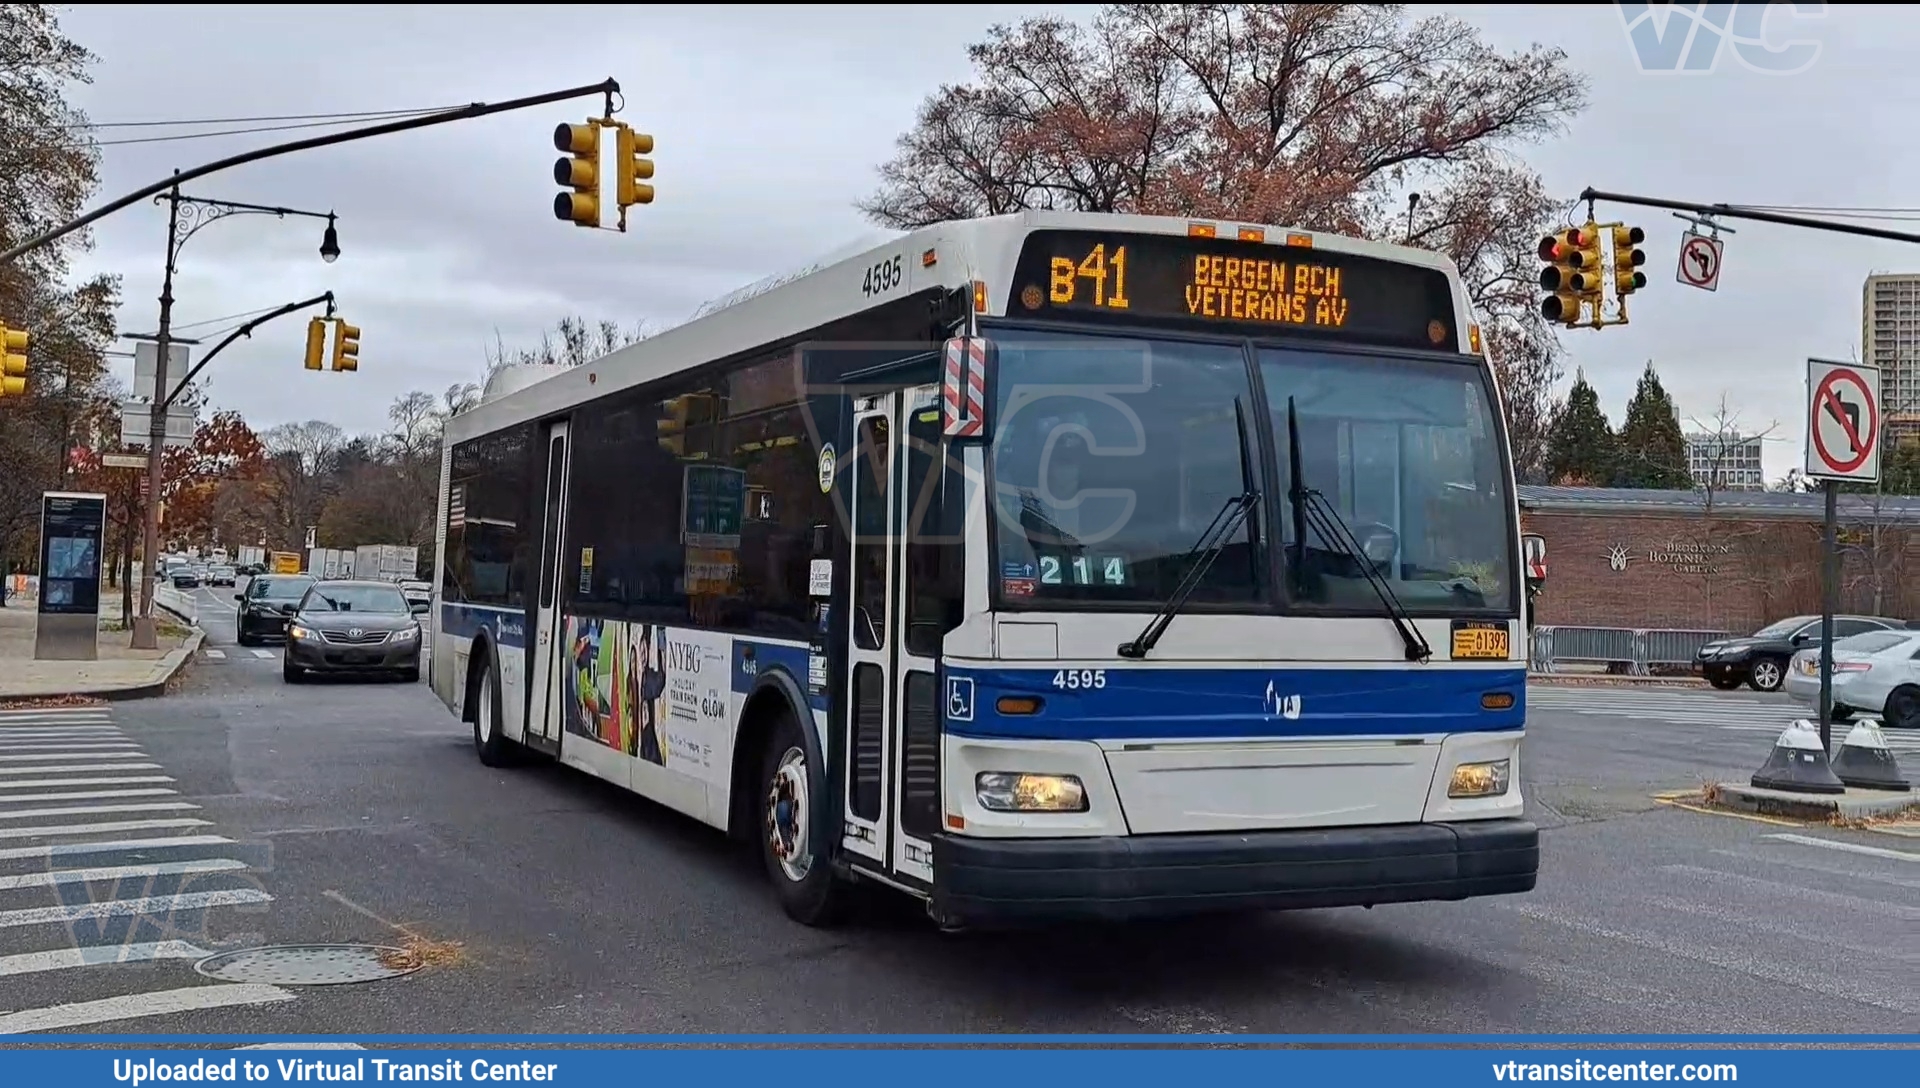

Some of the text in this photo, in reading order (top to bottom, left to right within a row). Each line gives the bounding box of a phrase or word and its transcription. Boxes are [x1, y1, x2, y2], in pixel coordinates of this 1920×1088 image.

[862, 254, 902, 298] 4595
[1050, 243, 1129, 308] B41
[1195, 254, 1340, 298] BERGEN BCH
[1185, 284, 1348, 327] VETERANS AV
[668, 641, 701, 674] NYBG
[1052, 670, 1106, 689] 4595
[702, 698, 725, 719] GLOW
